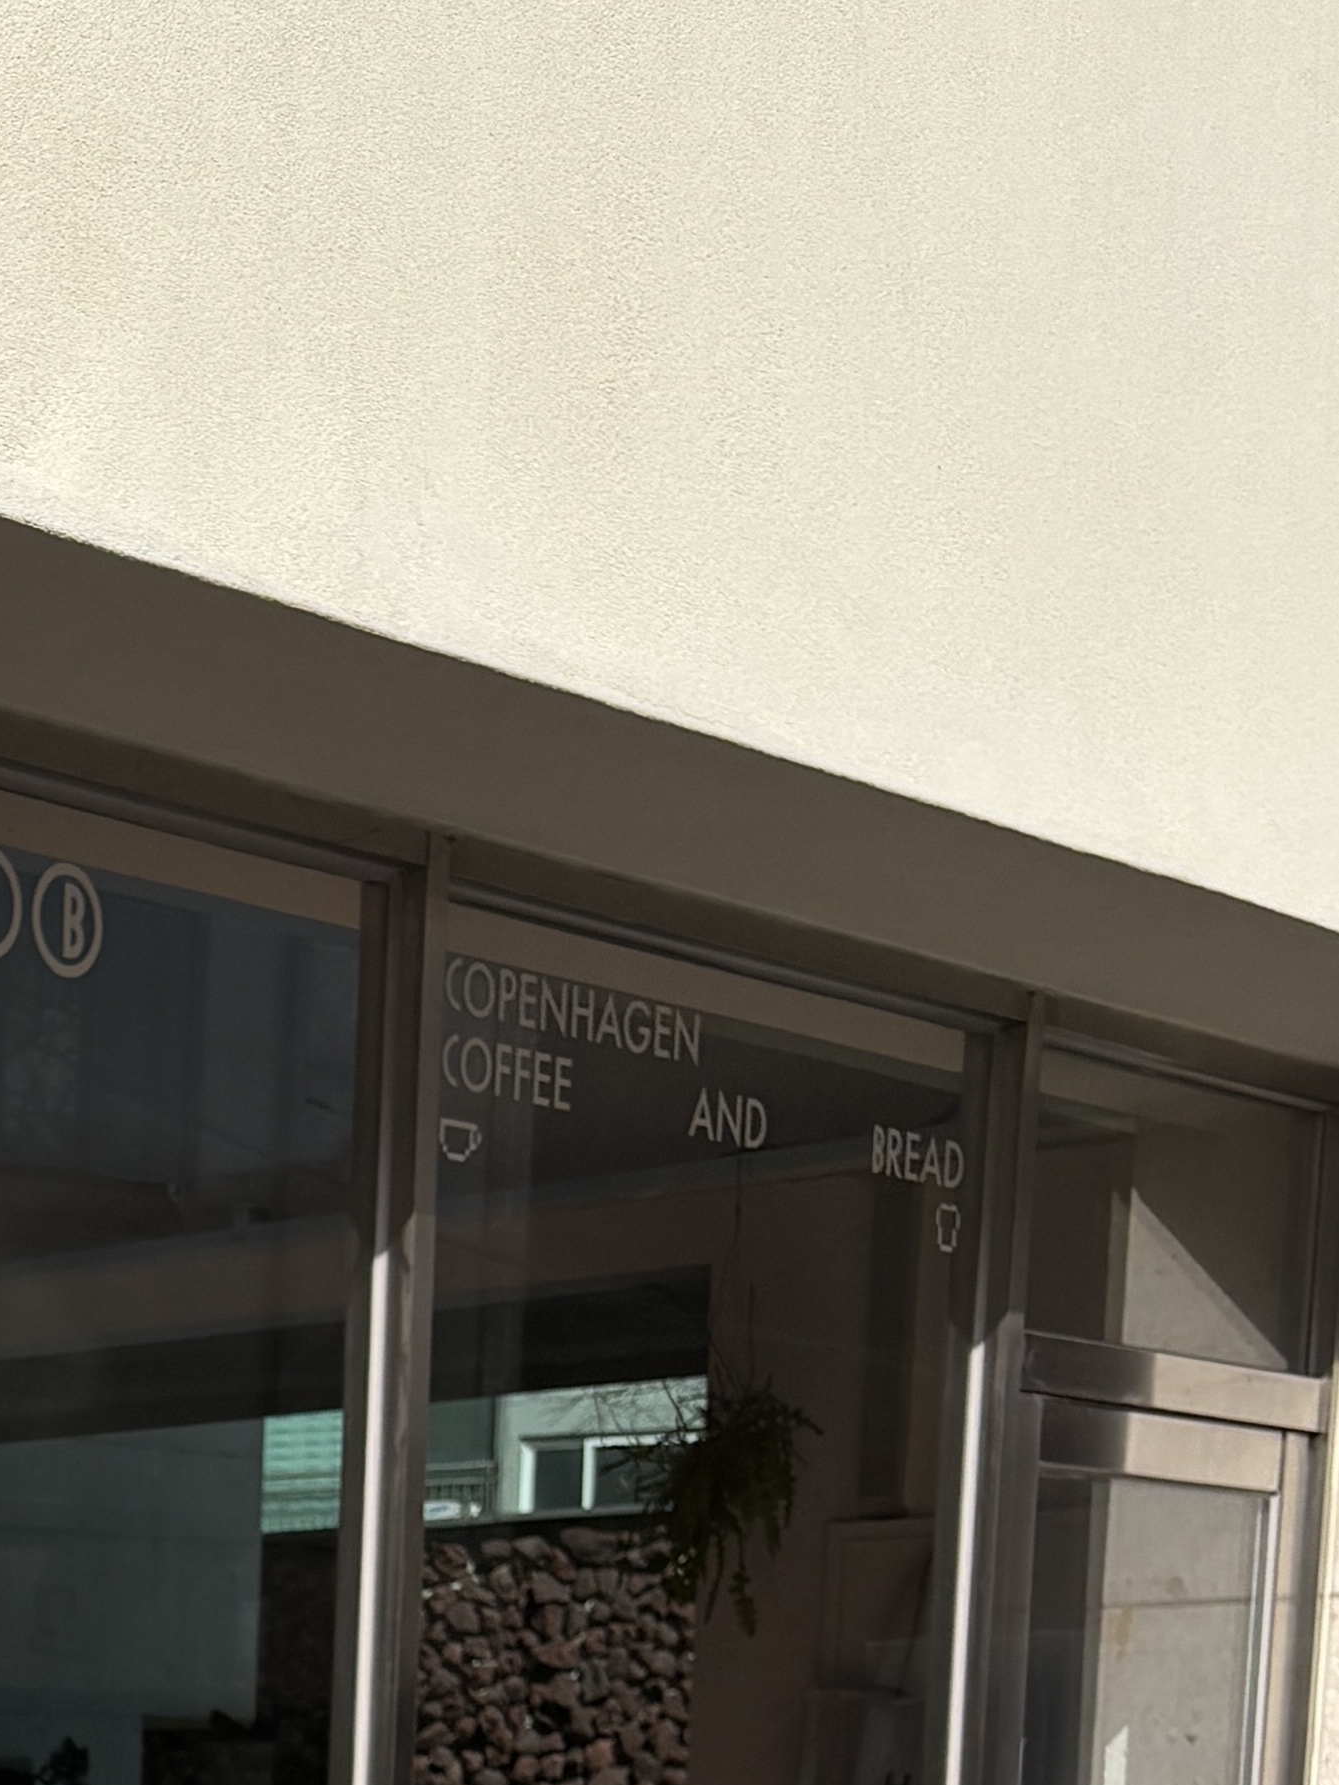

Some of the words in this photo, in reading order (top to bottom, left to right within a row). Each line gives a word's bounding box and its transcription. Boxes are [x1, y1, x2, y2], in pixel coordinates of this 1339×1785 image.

[446, 957, 701, 1067] COPENHAGEN
[441, 1033, 573, 1112] COFFEE
[688, 1087, 768, 1150] AND
[872, 1123, 965, 1189] BREAD
